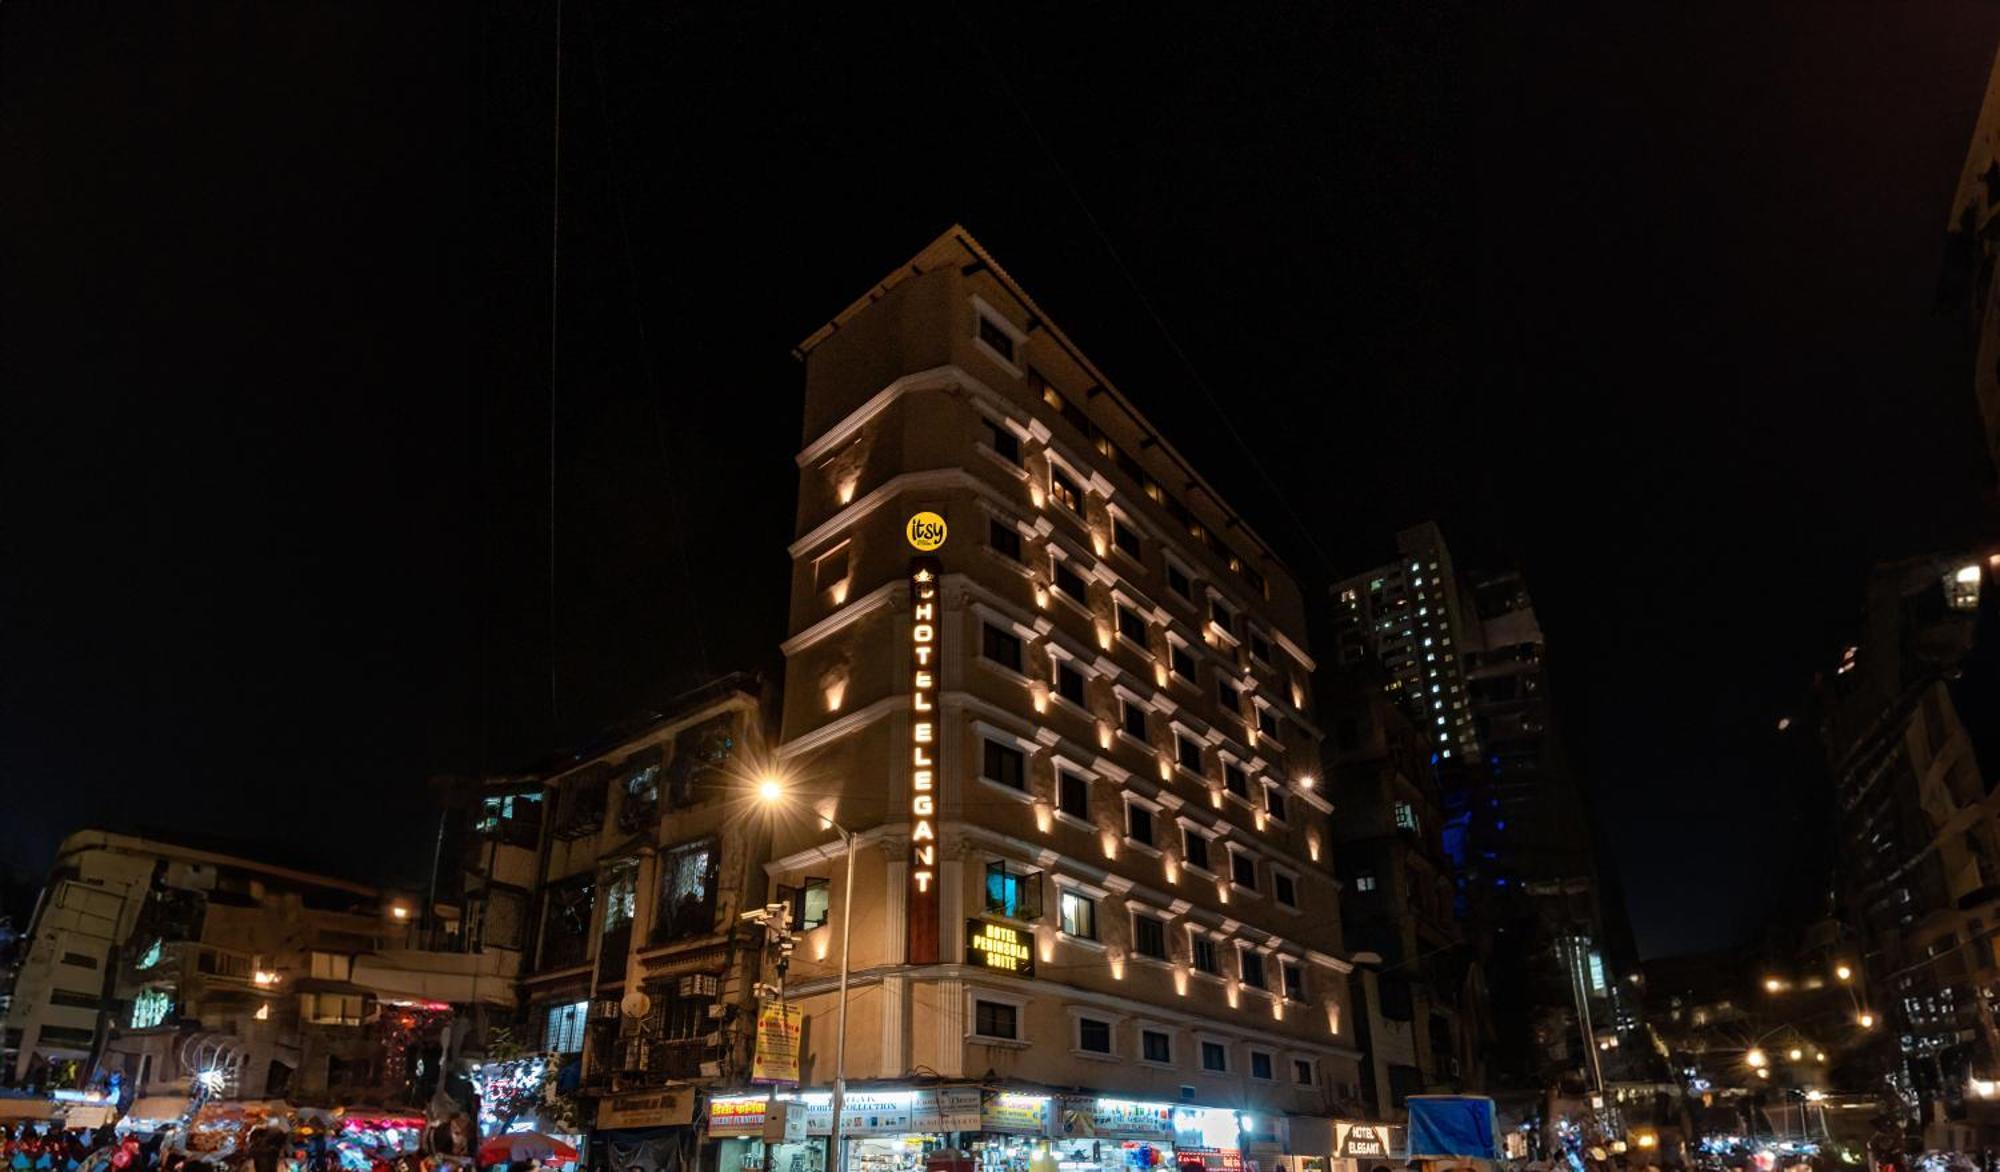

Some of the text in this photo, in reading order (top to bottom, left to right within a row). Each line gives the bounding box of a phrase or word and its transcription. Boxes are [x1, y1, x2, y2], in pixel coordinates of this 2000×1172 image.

[912, 519, 943, 545] itsy
[913, 603, 934, 893] HOTEL ELEGANT
[986, 924, 1017, 943] HOTEL
[973, 935, 1029, 960] PENINSULA
[987, 952, 1017, 970] SUITE
[1352, 1126, 1375, 1139] HOTEL
[1348, 1141, 1380, 1154] ELEGANT
